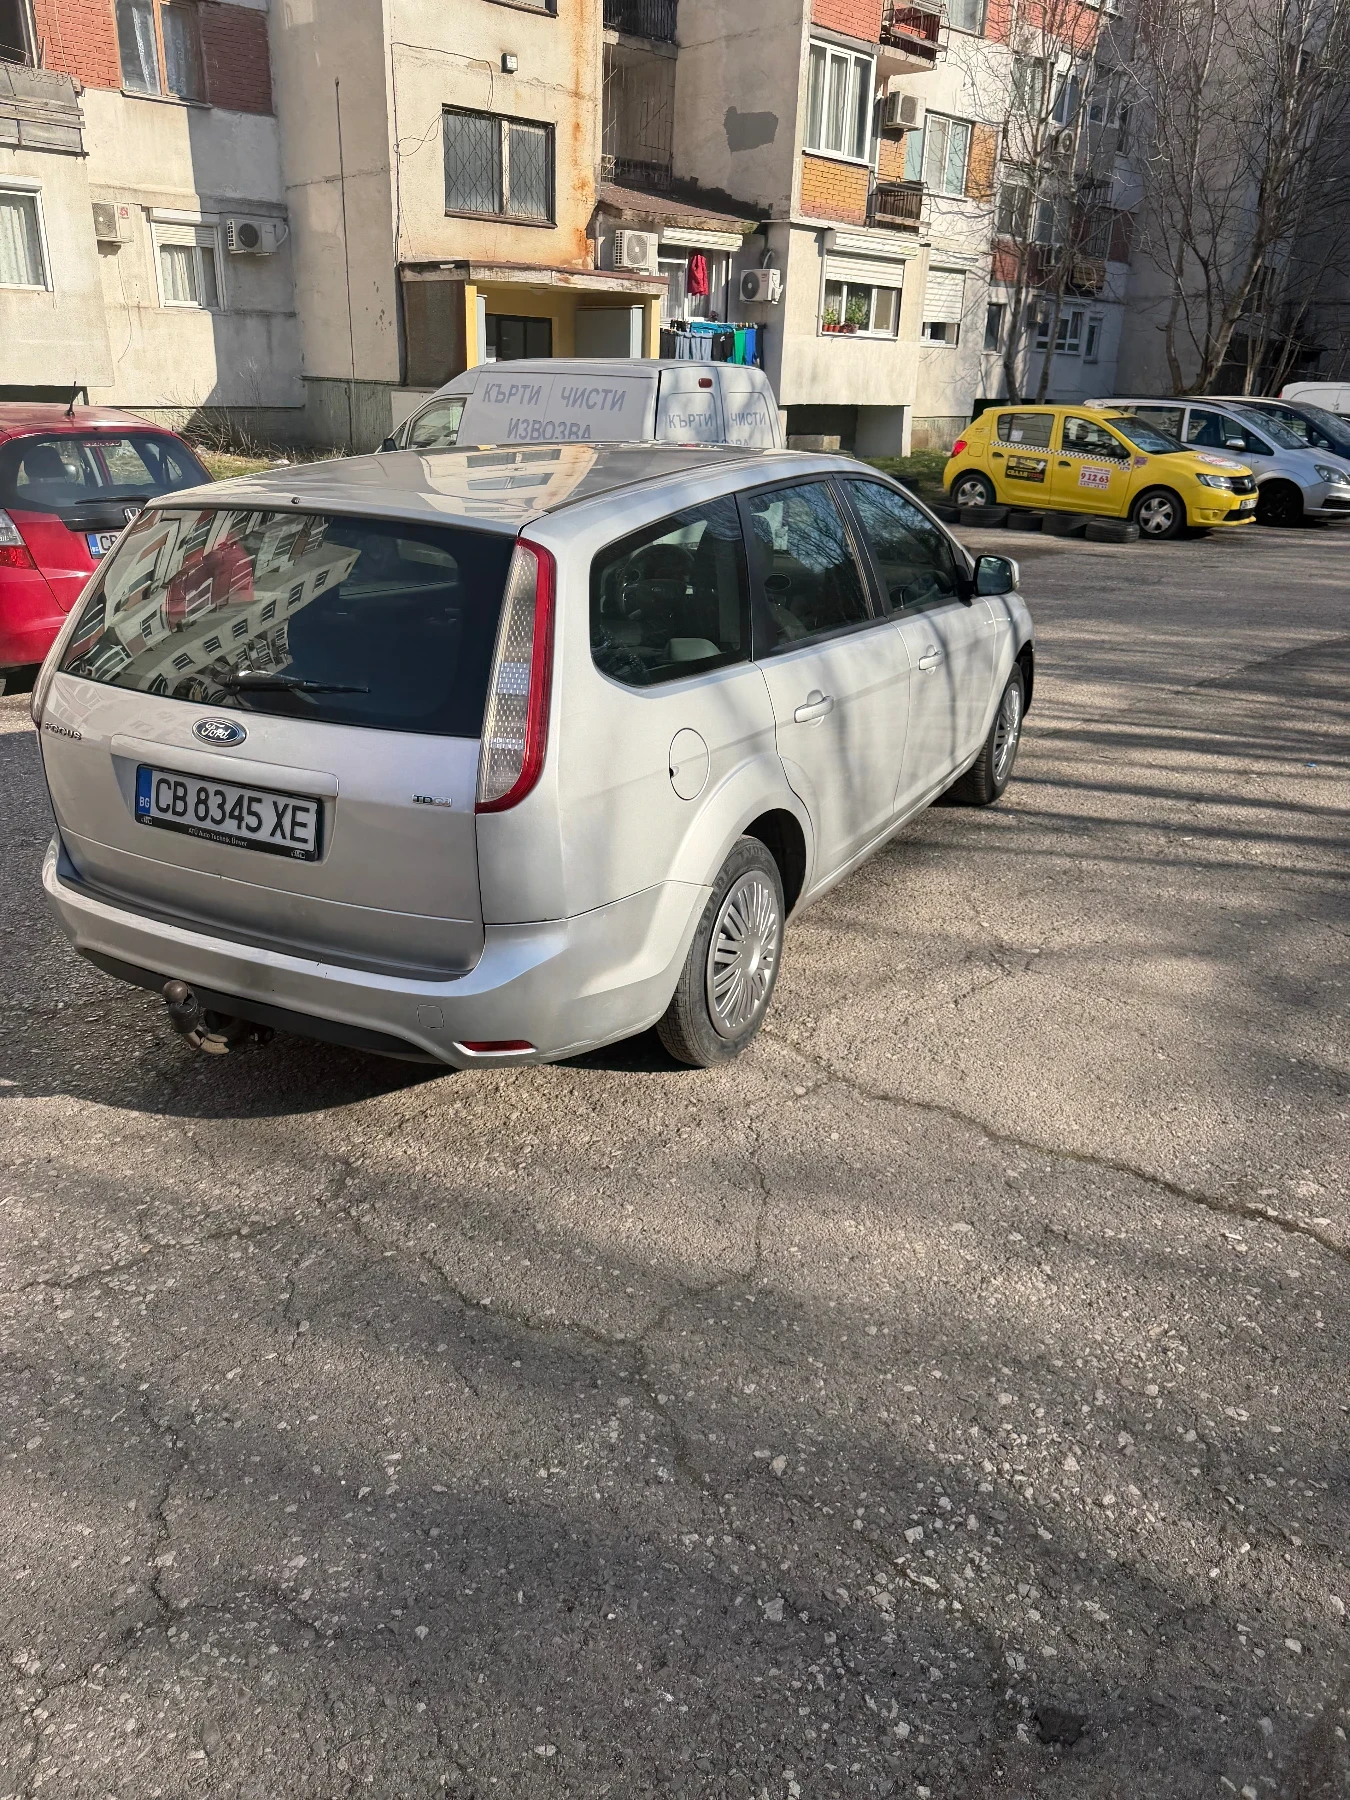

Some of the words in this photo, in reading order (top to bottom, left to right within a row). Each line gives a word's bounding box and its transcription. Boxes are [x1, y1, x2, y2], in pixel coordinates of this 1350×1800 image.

[482, 383, 542, 405] КЪРТИ
[560, 386, 626, 412] ЧИСТИ
[506, 417, 592, 440] ИЗВОЗВА
[668, 413, 713, 428] КЪРТИ
[730, 412, 766, 426] ЧИСТИ
[45, 721, 82, 740] FOCUS
[201, 721, 231, 740] Ford
[139, 796, 150, 808] BG
[155, 777, 188, 817] CB
[194, 786, 263, 833] 8345
[269, 800, 310, 844] XE
